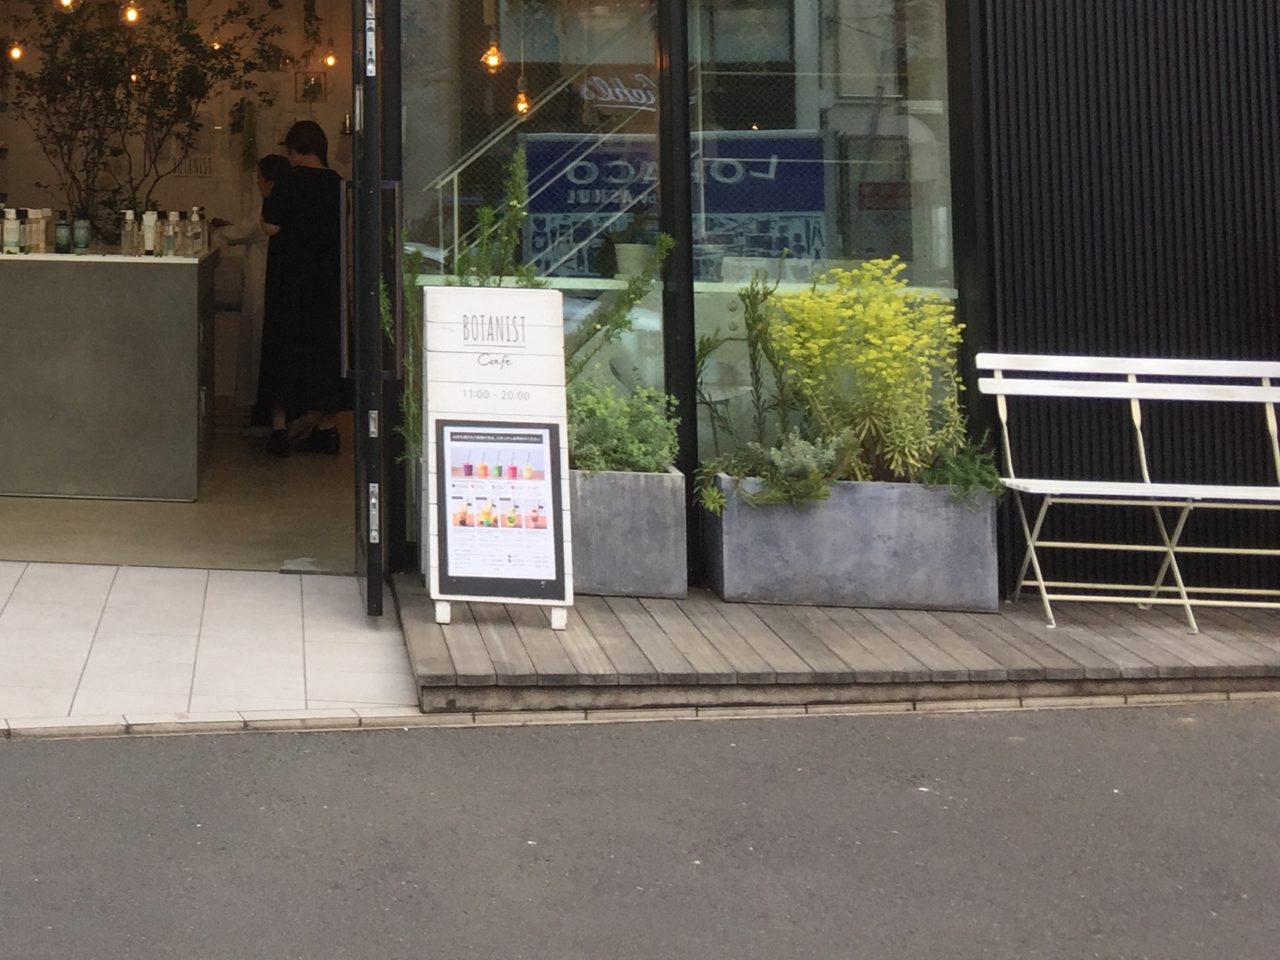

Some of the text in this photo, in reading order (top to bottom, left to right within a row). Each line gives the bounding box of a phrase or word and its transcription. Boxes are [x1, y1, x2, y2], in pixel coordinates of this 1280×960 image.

[462, 314, 526, 342] BOTANIST
[477, 352, 512, 370] Cafe
[463, 388, 490, 399] 11:00
[501, 390, 530, 400] 20:00
